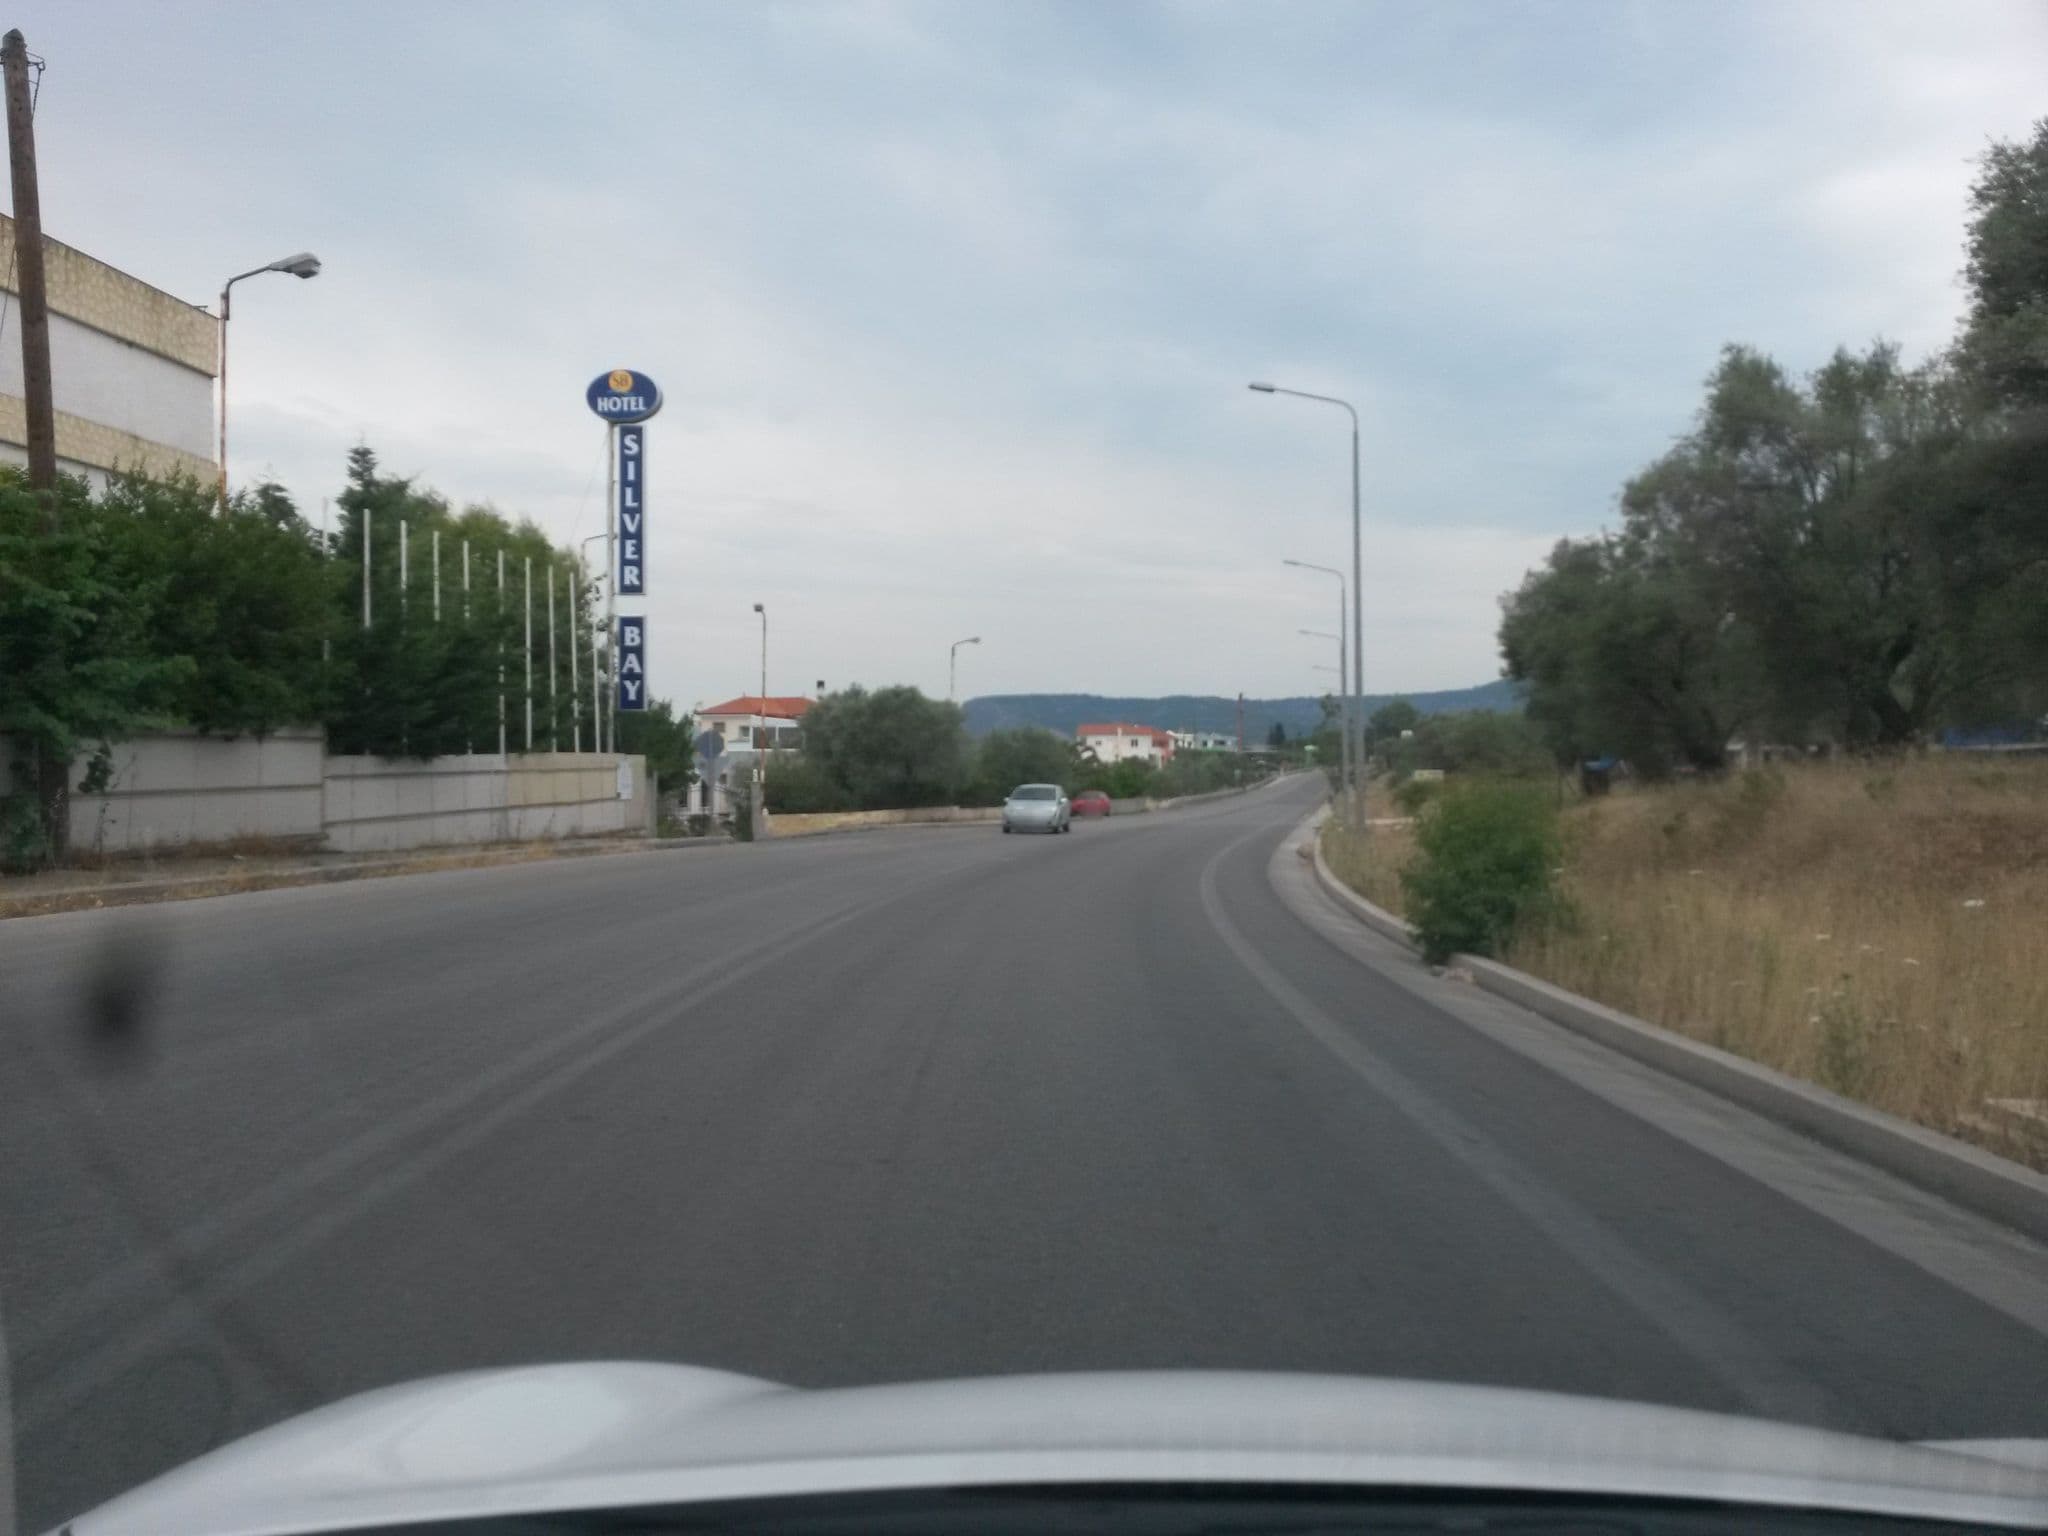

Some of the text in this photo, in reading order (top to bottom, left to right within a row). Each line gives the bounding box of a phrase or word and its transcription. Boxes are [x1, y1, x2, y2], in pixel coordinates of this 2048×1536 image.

[597, 397, 646, 411] HOTEL
[622, 434, 641, 701] SILVER BAY
